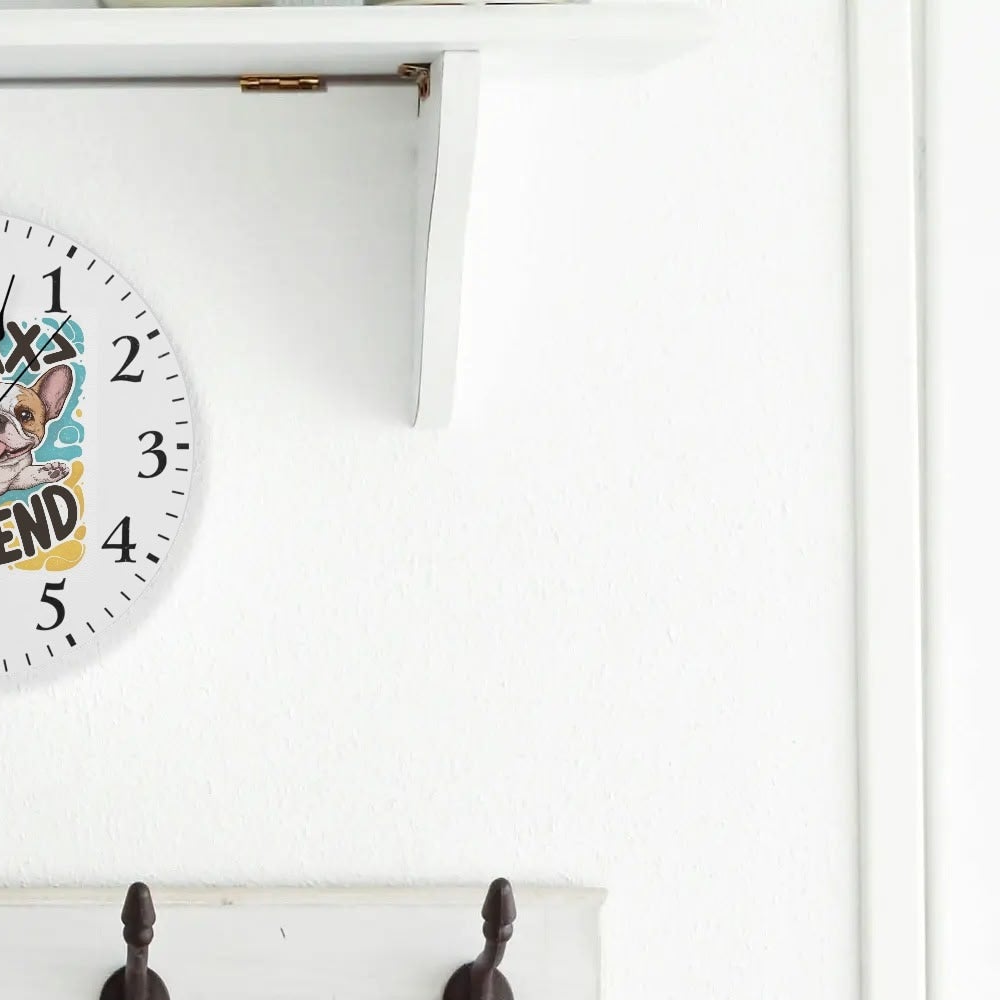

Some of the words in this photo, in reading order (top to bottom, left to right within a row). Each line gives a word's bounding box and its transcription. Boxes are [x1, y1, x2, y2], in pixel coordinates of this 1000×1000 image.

[42, 266, 68, 314] 1
[110, 335, 145, 383] 2
[137, 430, 168, 479] 3
[101, 515, 137, 563] 4
[35, 577, 67, 631] 5
